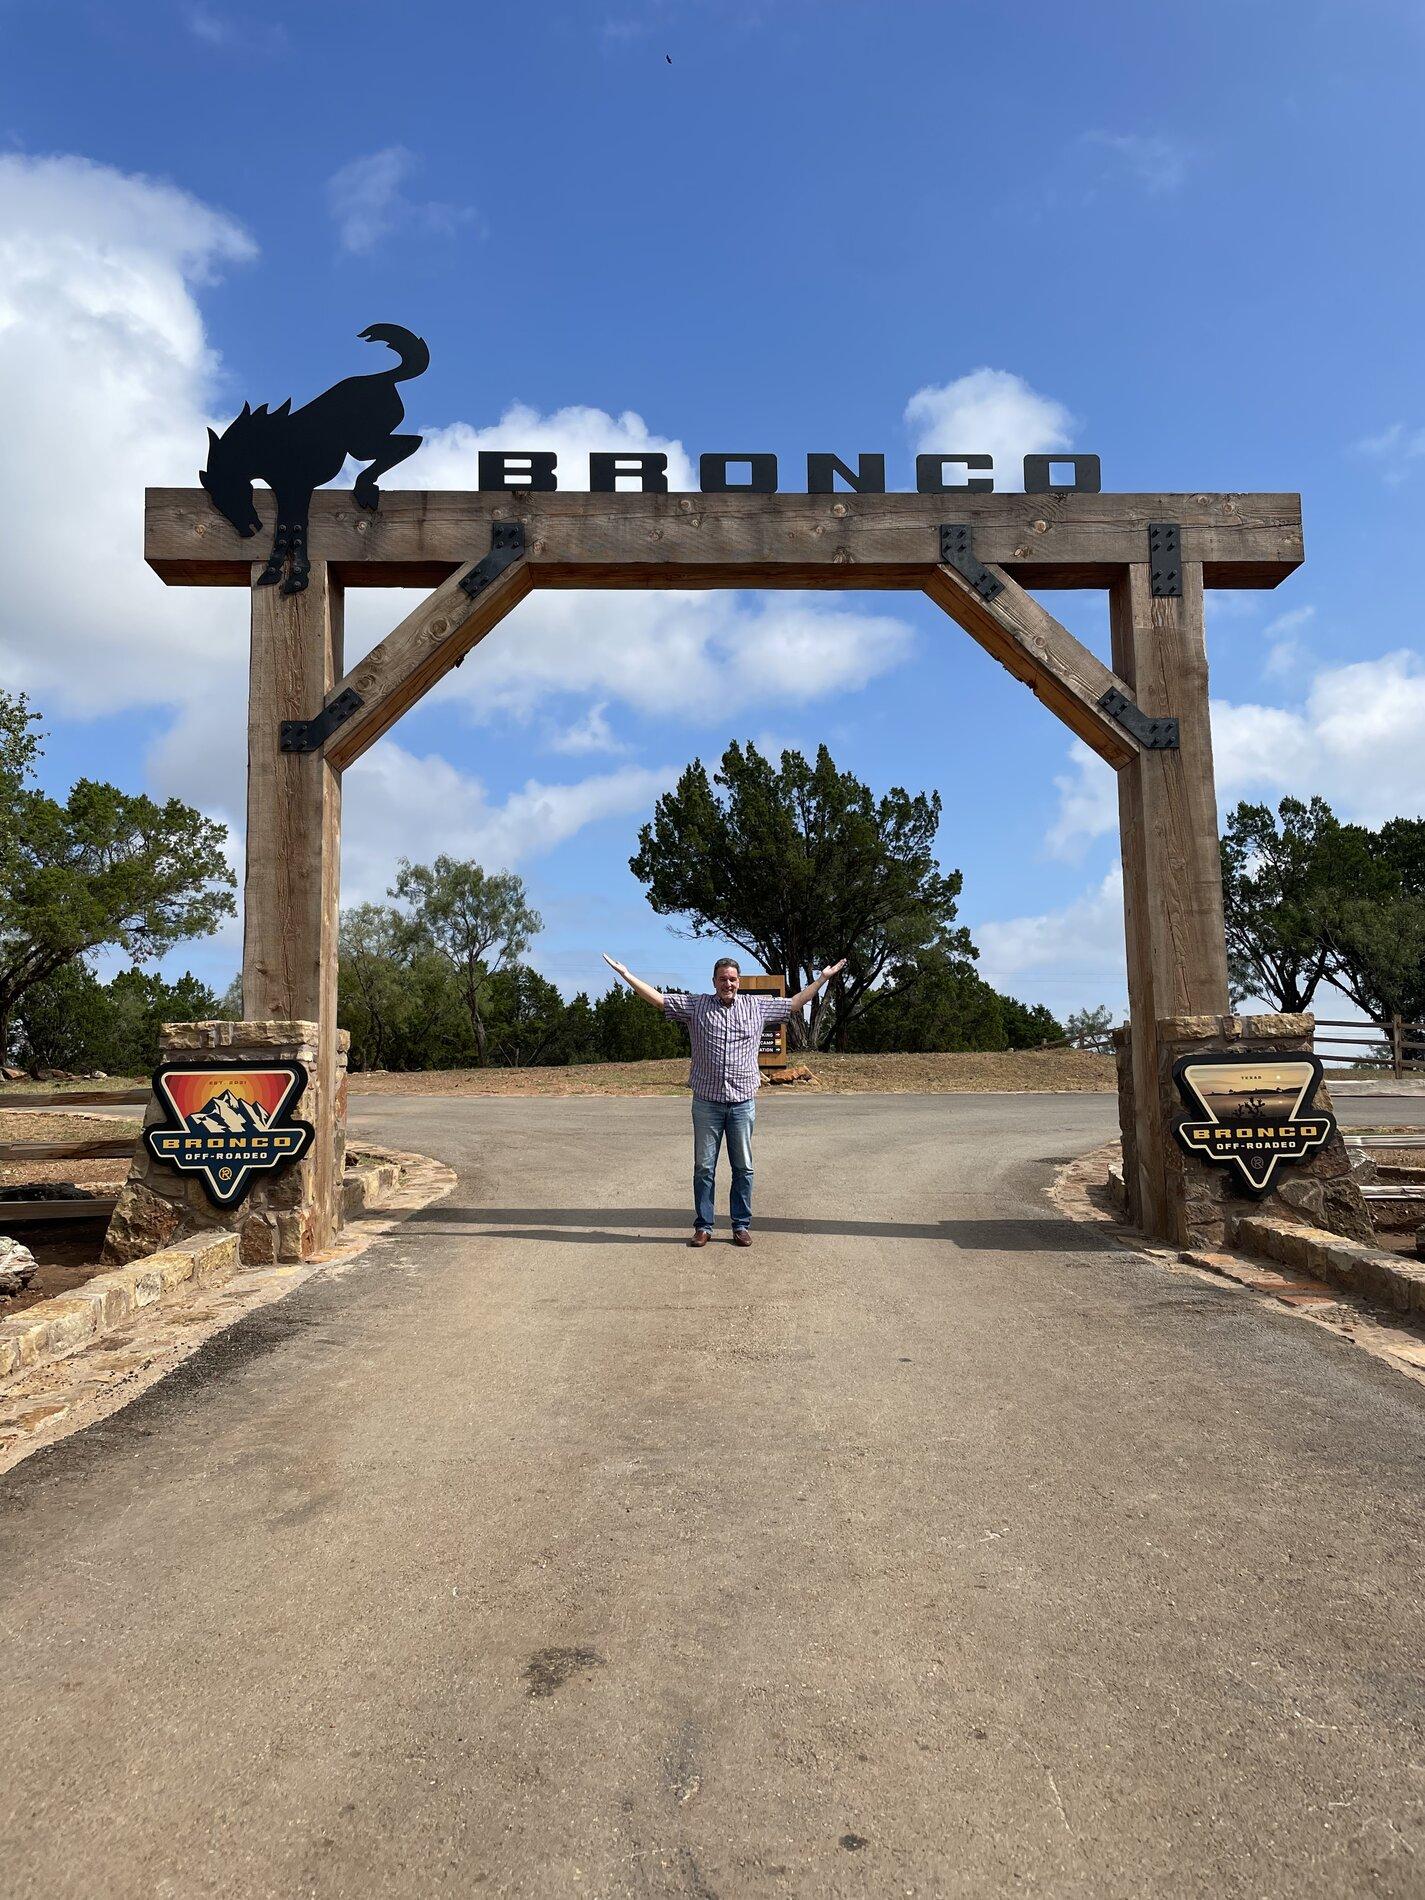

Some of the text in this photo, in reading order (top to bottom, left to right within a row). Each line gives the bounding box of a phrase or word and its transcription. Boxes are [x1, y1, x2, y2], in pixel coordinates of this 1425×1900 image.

[478, 451, 1101, 493] BRONCO
[1193, 1126, 1317, 1140] BRONCO
[162, 1137, 292, 1149] BRONCO
[1216, 1141, 1296, 1150] OFF-ROADEO
[185, 1152, 268, 1161] OFF-ROADEO
